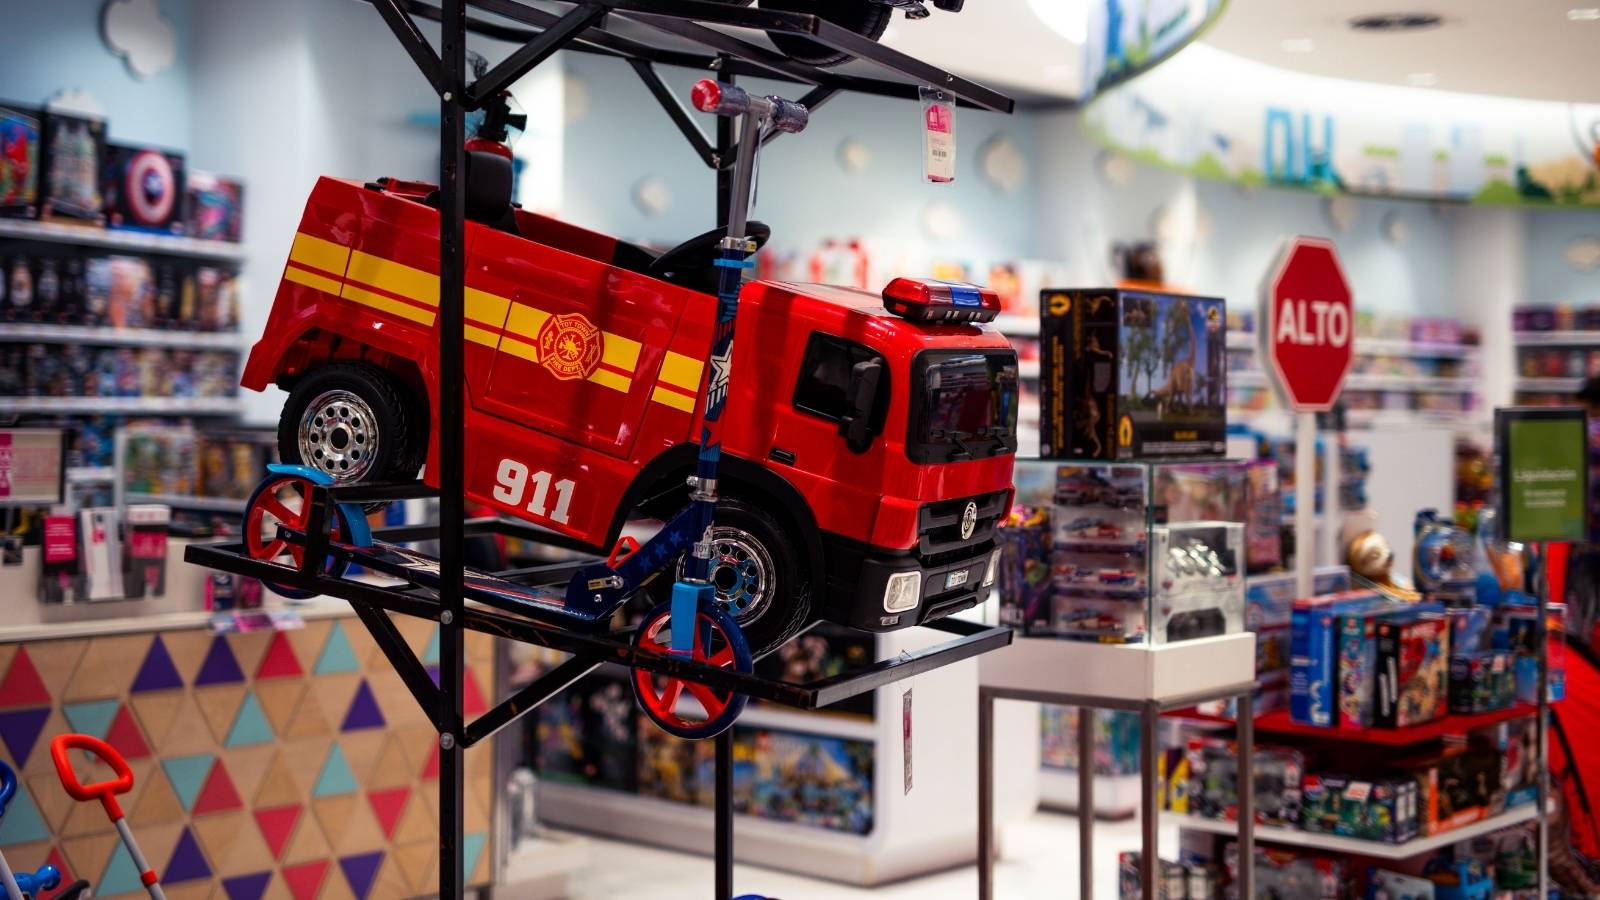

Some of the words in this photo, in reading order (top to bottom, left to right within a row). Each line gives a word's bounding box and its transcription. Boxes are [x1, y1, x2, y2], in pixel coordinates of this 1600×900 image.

[560, 321, 573, 329] TOY
[574, 321, 591, 337] TOWN
[1278, 298, 1349, 347] ALTO
[550, 356, 562, 369] FIRE
[493, 458, 576, 525] 911
